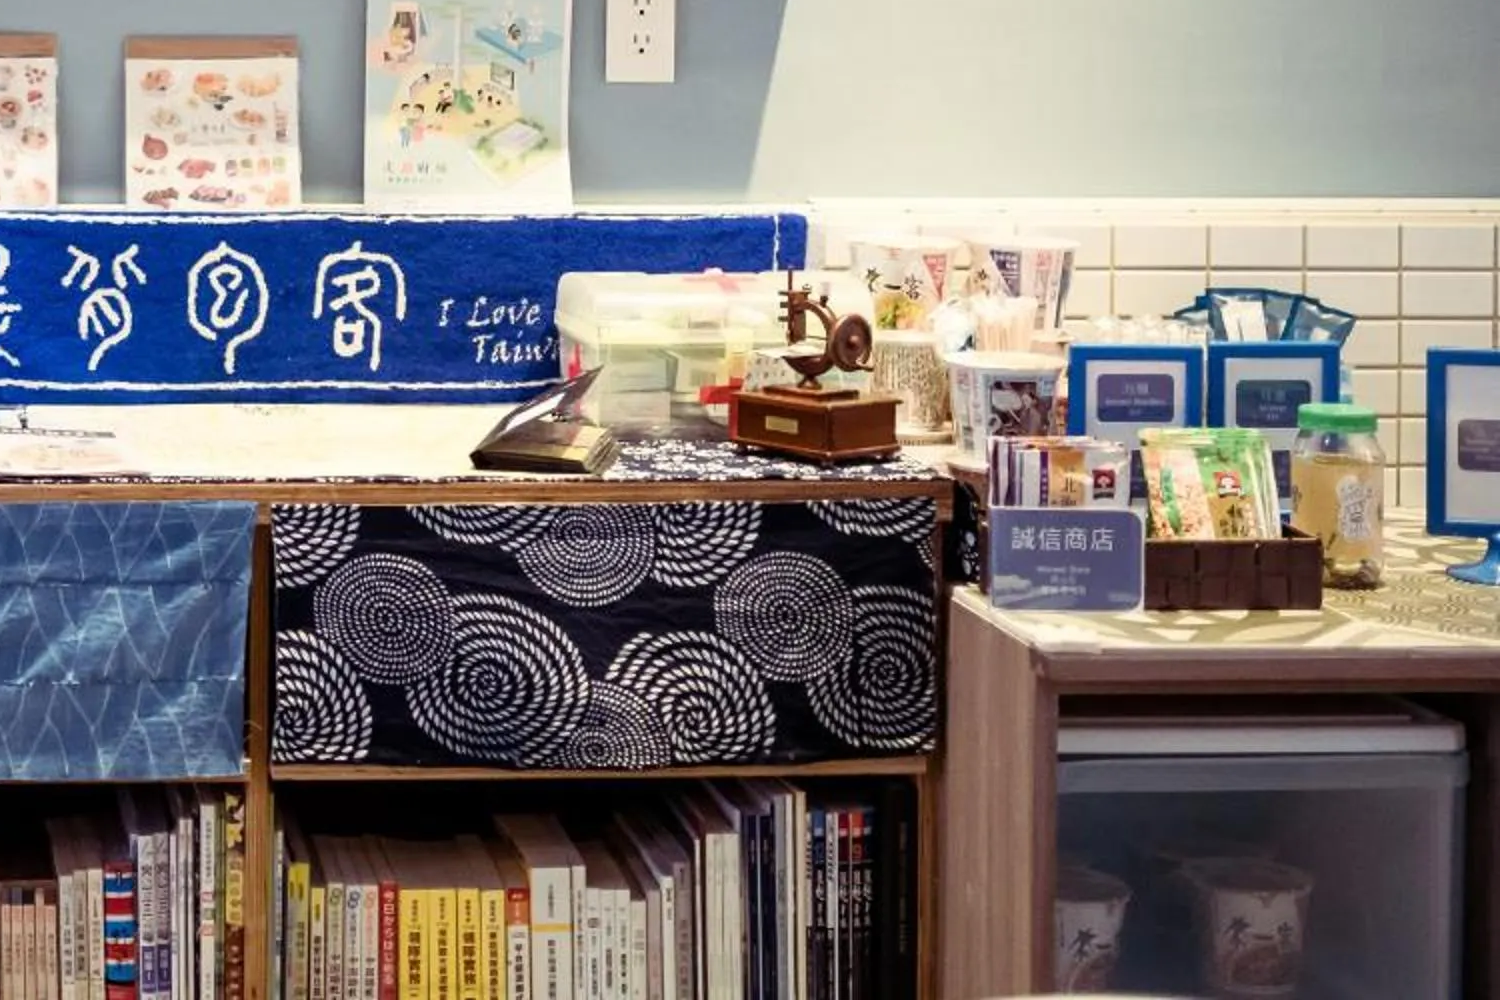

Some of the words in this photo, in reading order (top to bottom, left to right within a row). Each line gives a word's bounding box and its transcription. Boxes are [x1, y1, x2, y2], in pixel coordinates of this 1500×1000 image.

[466, 296, 541, 328] Love
[1010, 525, 1116, 552] 誠信商店
